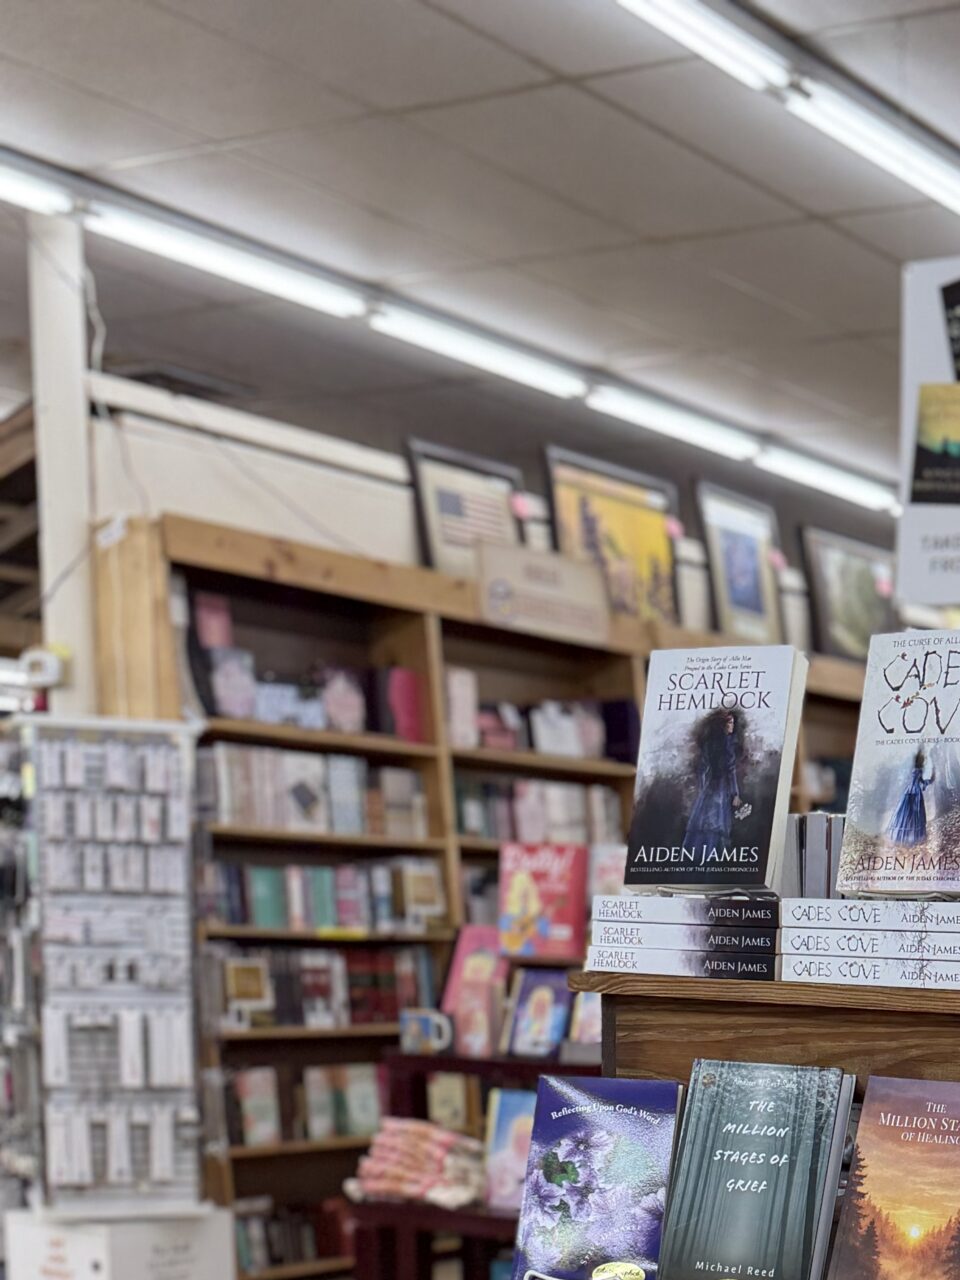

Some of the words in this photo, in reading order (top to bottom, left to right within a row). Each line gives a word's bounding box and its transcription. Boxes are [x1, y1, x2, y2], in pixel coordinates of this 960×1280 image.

[668, 671, 765, 694] SCARLET
[658, 691, 772, 710] HEMLOCK
[635, 846, 694, 862] AIDEN
[700, 845, 758, 865] JAMES
[792, 906, 831, 921] CADES
[838, 905, 880, 923] COVE
[550, 1103, 592, 1120] Reflecting
[593, 1103, 614, 1113] Upon
[615, 1104, 638, 1116] God's
[639, 1110, 660, 1124] Word
[749, 1101, 775, 1112] THE
[926, 1102, 947, 1113] THE
[878, 1112, 938, 1129] MILLION
[722, 1124, 790, 1138] MILLION
[714, 1150, 767, 1164] STAGES
[769, 1154, 789, 1166] OF
[726, 1180, 768, 1193] GRIEF
[695, 1261, 742, 1275] Michael
[747, 1266, 775, 1278] Reed
